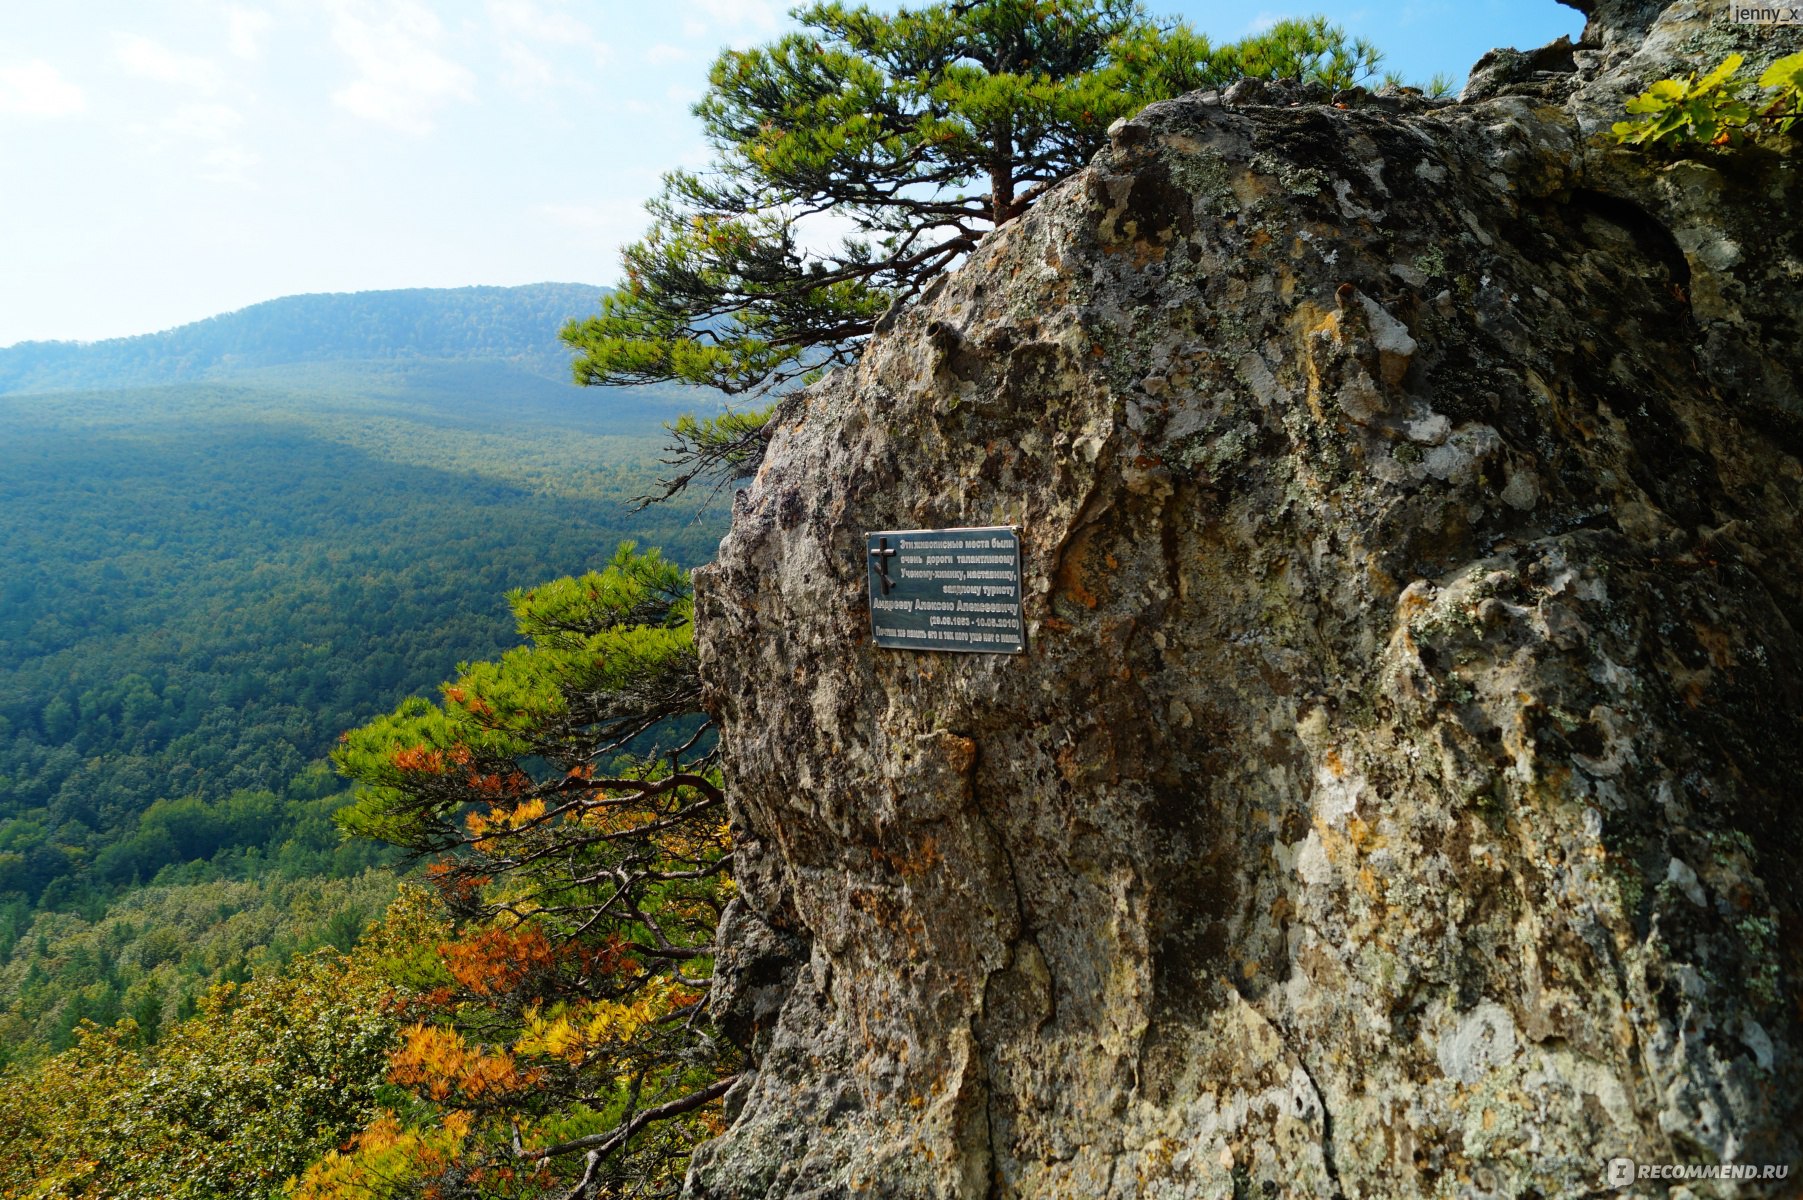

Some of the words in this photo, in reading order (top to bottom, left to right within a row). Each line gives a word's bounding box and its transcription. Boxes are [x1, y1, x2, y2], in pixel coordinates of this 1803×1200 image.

[900, 539, 913, 549] Эти
[914, 539, 963, 549] живописные
[965, 539, 990, 549] места
[991, 537, 1014, 549] были
[900, 555, 922, 564] очень
[926, 555, 953, 566] дороги
[956, 555, 1015, 566] талантливому
[967, 570, 1017, 581] наставнику,
[982, 586, 1015, 596] туристу
[873, 597, 913, 613] Андрееву
[914, 598, 954, 610] Алексею
[956, 600, 1018, 616] Алексеевичу
[928, 630, 938, 639] его
[938, 631, 943, 640] и
[954, 632, 968, 641] кого
[969, 632, 982, 644] уже
[983, 632, 994, 642] нет
[995, 634, 1000, 642] с
